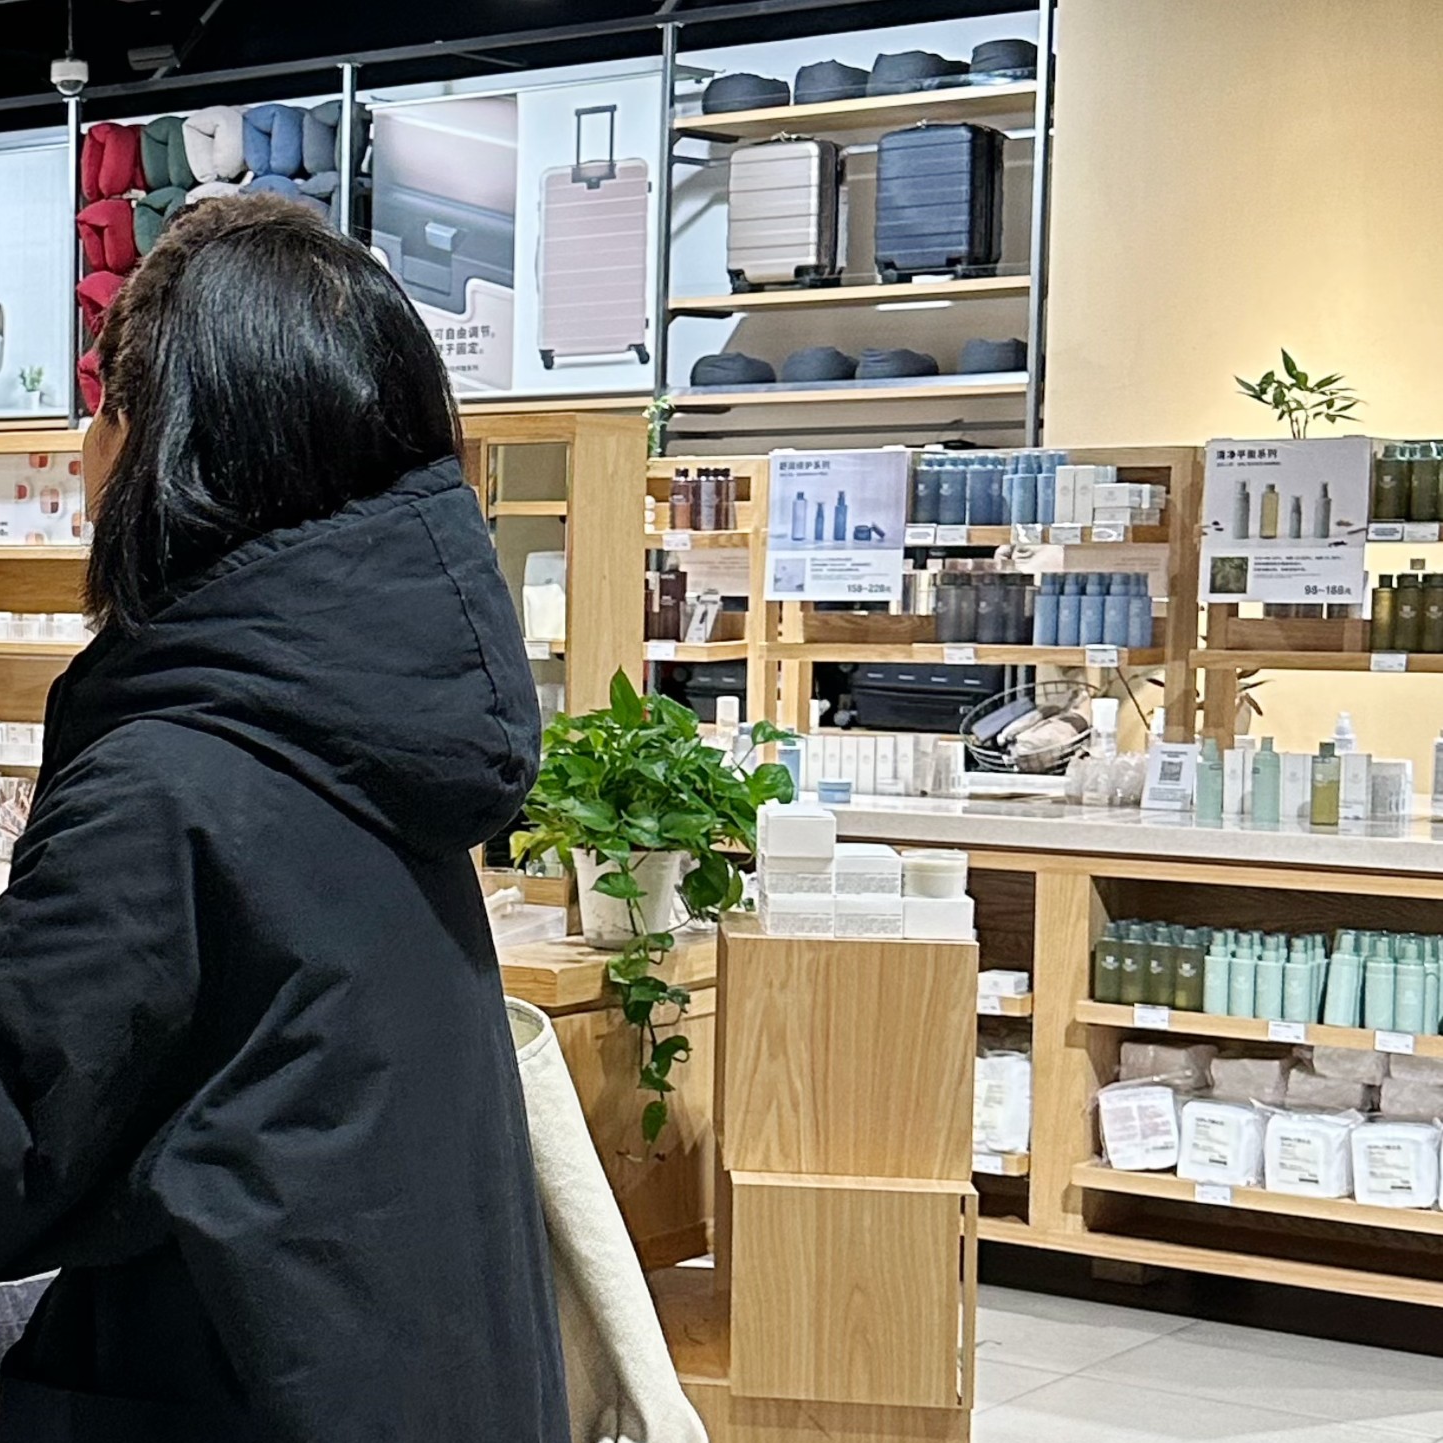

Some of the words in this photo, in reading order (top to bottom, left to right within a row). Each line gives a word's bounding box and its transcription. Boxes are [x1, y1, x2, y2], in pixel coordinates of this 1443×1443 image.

[429, 325, 495, 340] 可自由调节。
